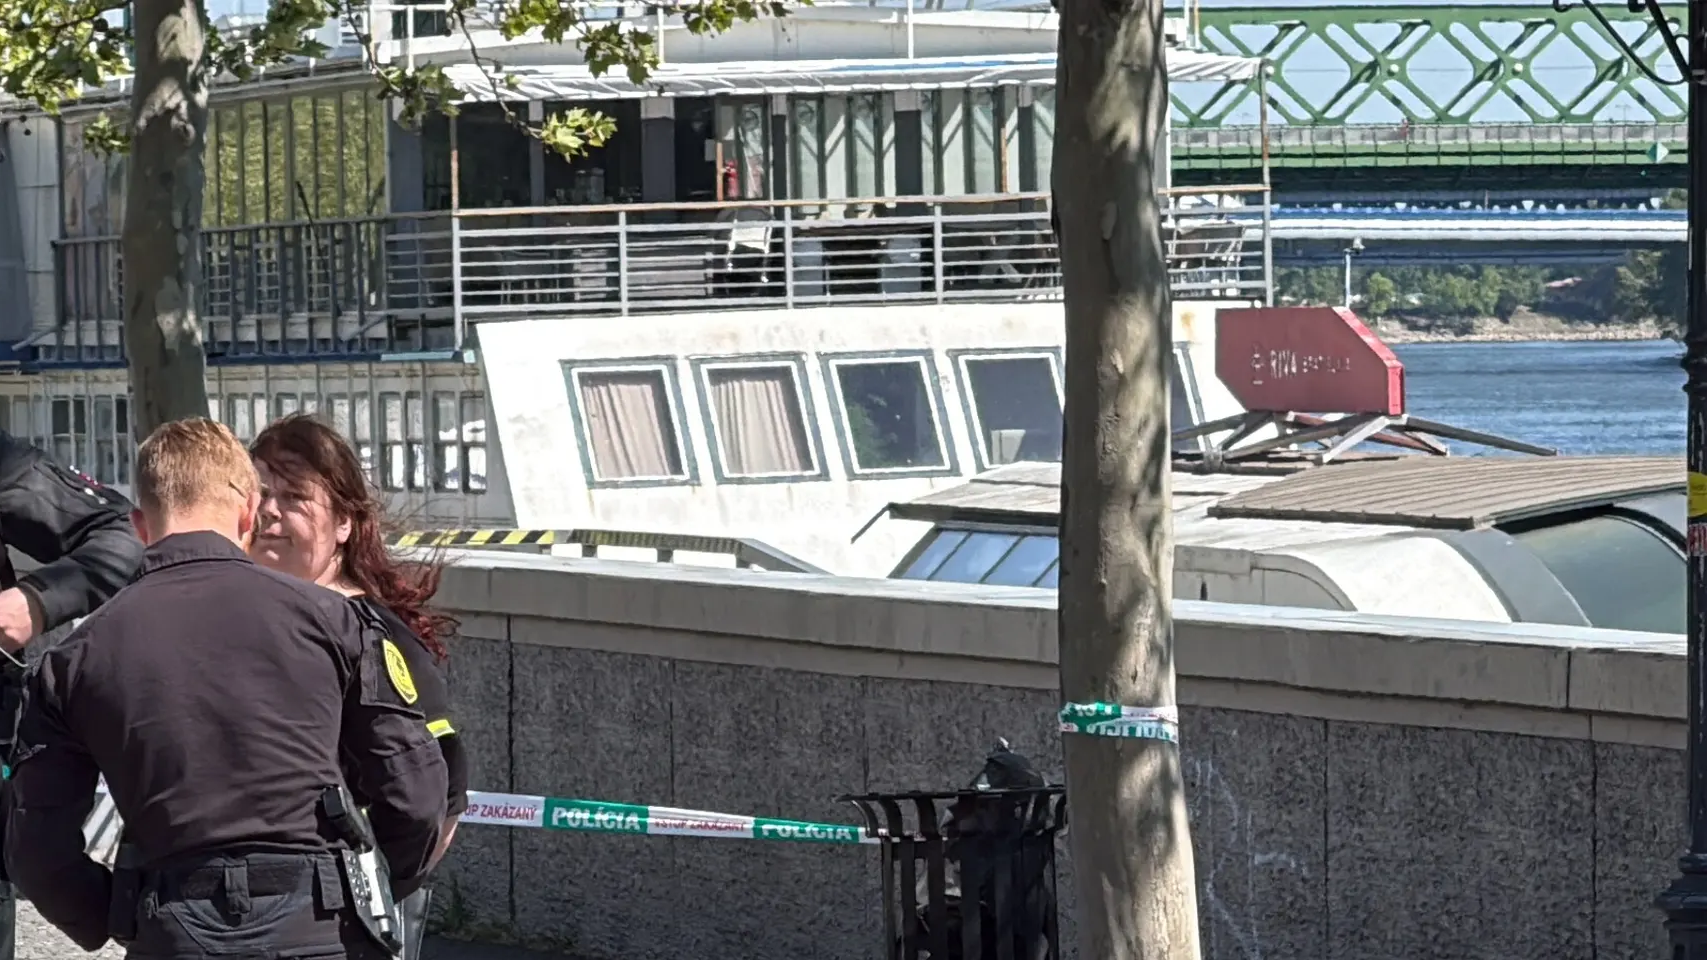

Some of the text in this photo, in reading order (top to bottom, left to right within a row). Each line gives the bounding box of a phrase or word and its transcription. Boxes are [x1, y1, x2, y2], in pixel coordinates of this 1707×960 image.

[480, 802, 538, 821] ZAKÁZANÝ
[552, 806, 641, 831] POLÍCIA
[762, 822, 852, 840] POLÍCIA
